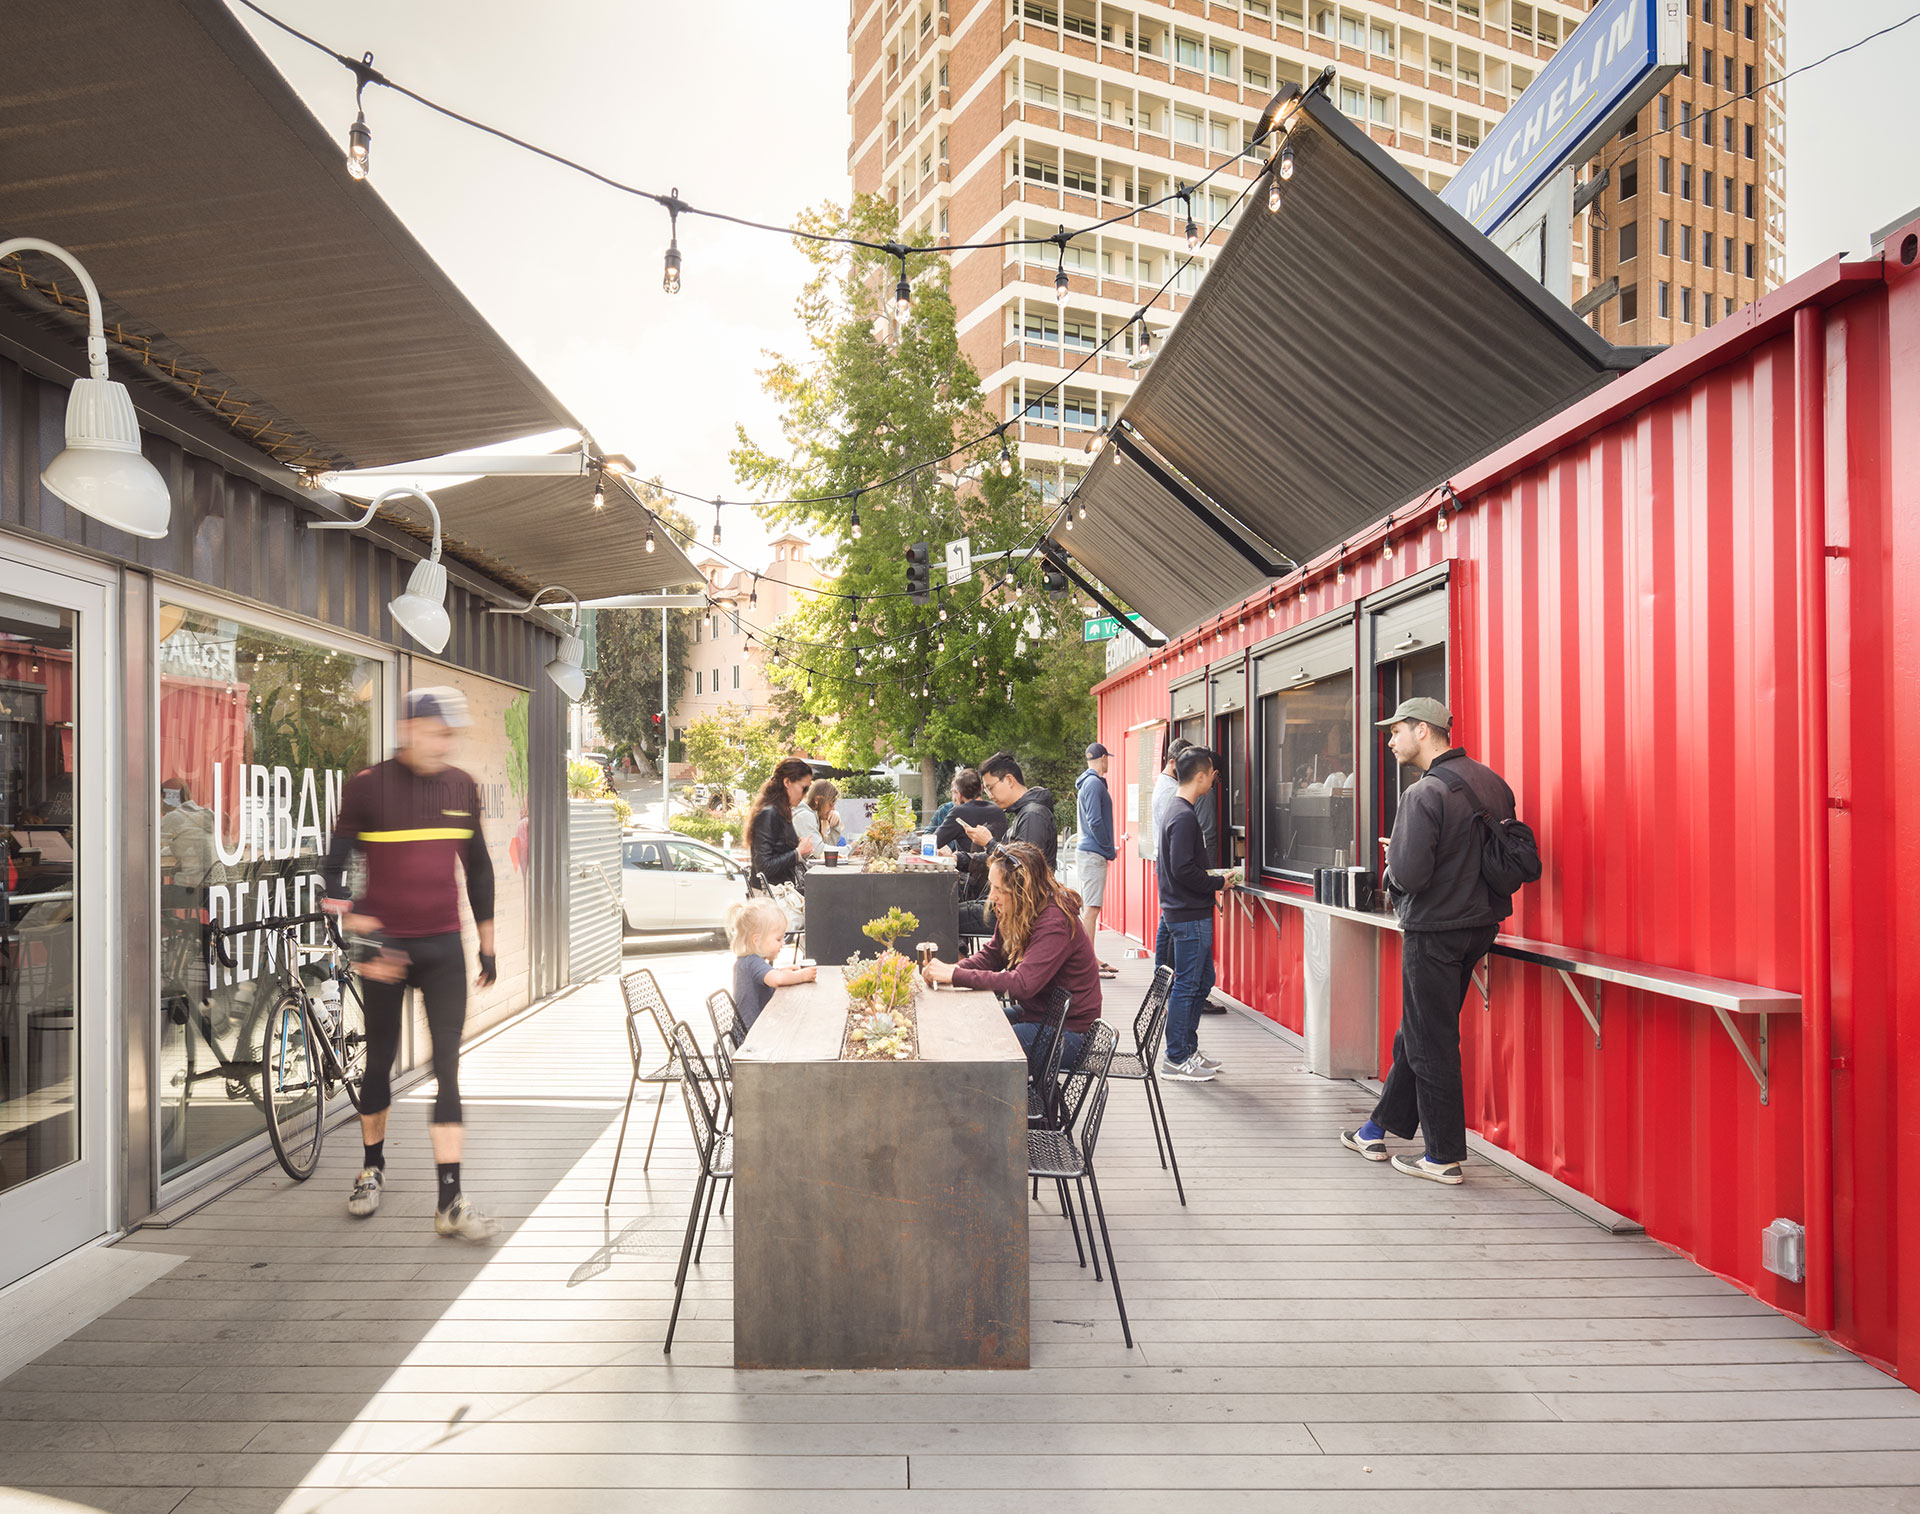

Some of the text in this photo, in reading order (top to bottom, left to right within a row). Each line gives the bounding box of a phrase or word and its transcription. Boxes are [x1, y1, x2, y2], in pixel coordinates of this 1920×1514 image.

[1464, 0, 1638, 218] MICHELIN
[1104, 621, 1119, 634] Ve
[214, 762, 343, 867] URBAN
